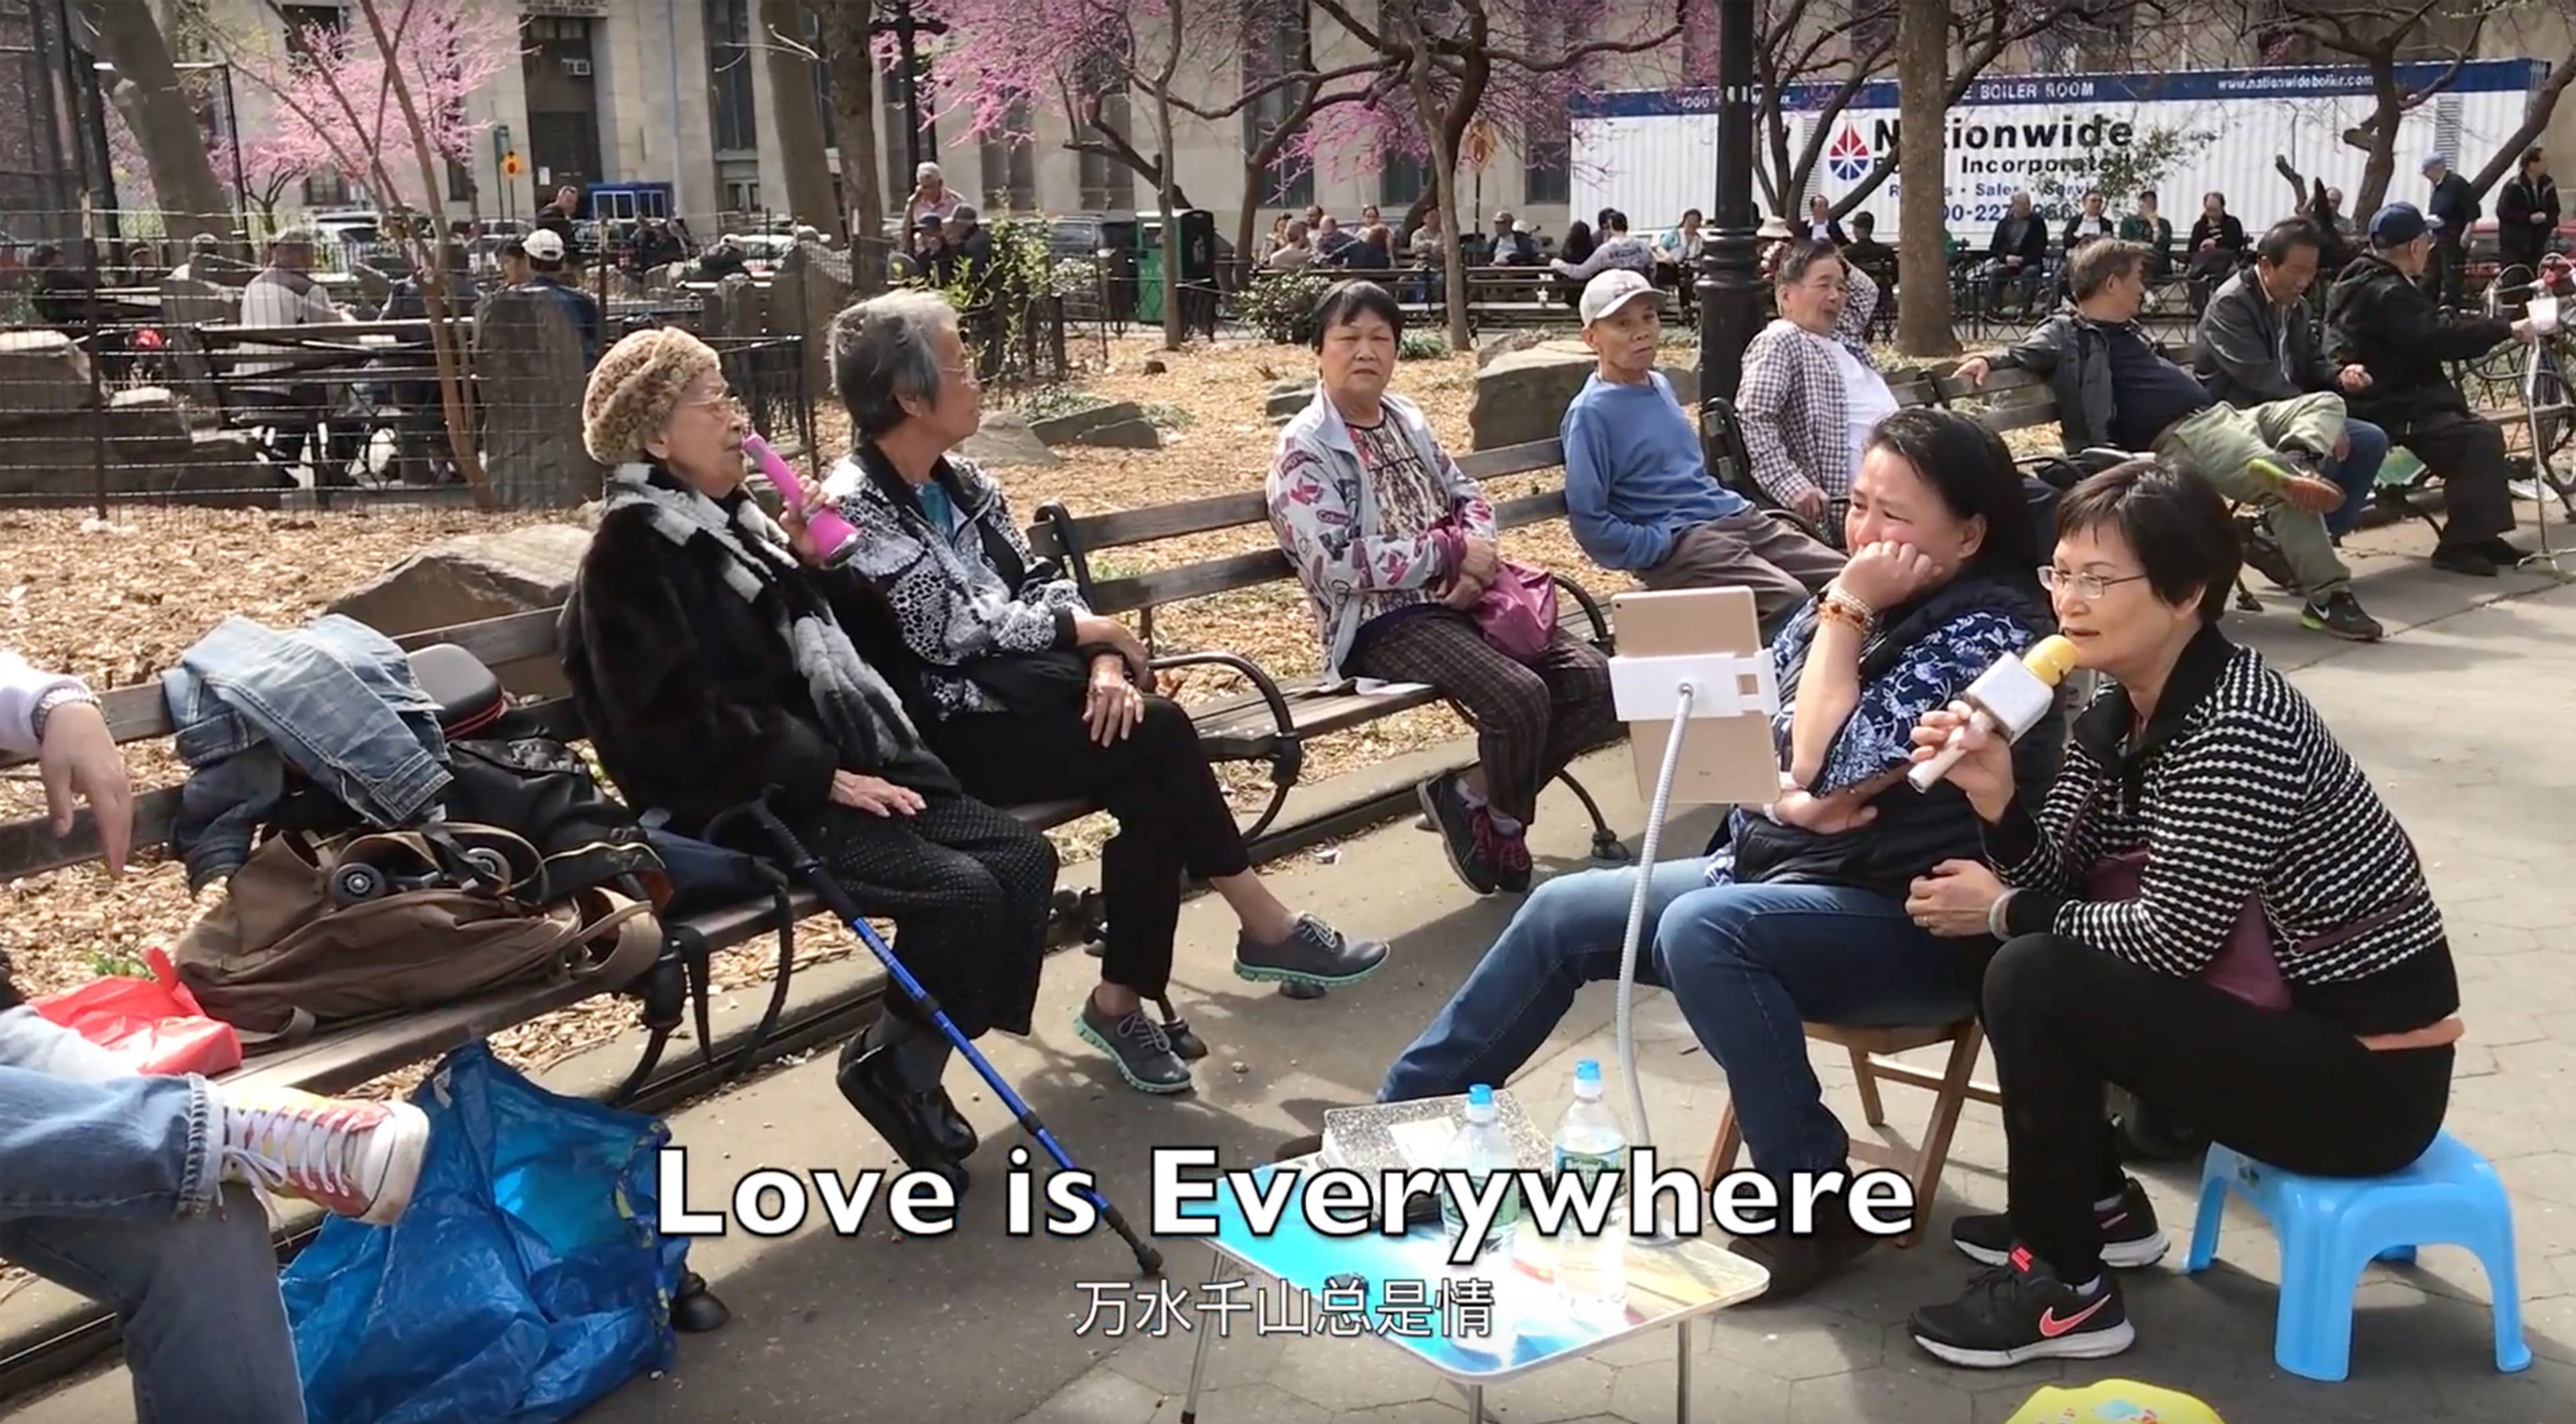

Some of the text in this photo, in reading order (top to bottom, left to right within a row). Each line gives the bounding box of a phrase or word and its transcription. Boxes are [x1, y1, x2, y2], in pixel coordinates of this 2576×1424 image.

[1980, 84, 2037, 100] BOILER
[2046, 82, 2094, 99] ROOM
[1875, 114, 2133, 152] Nionwide
[1962, 153, 2131, 175] Incorporate
